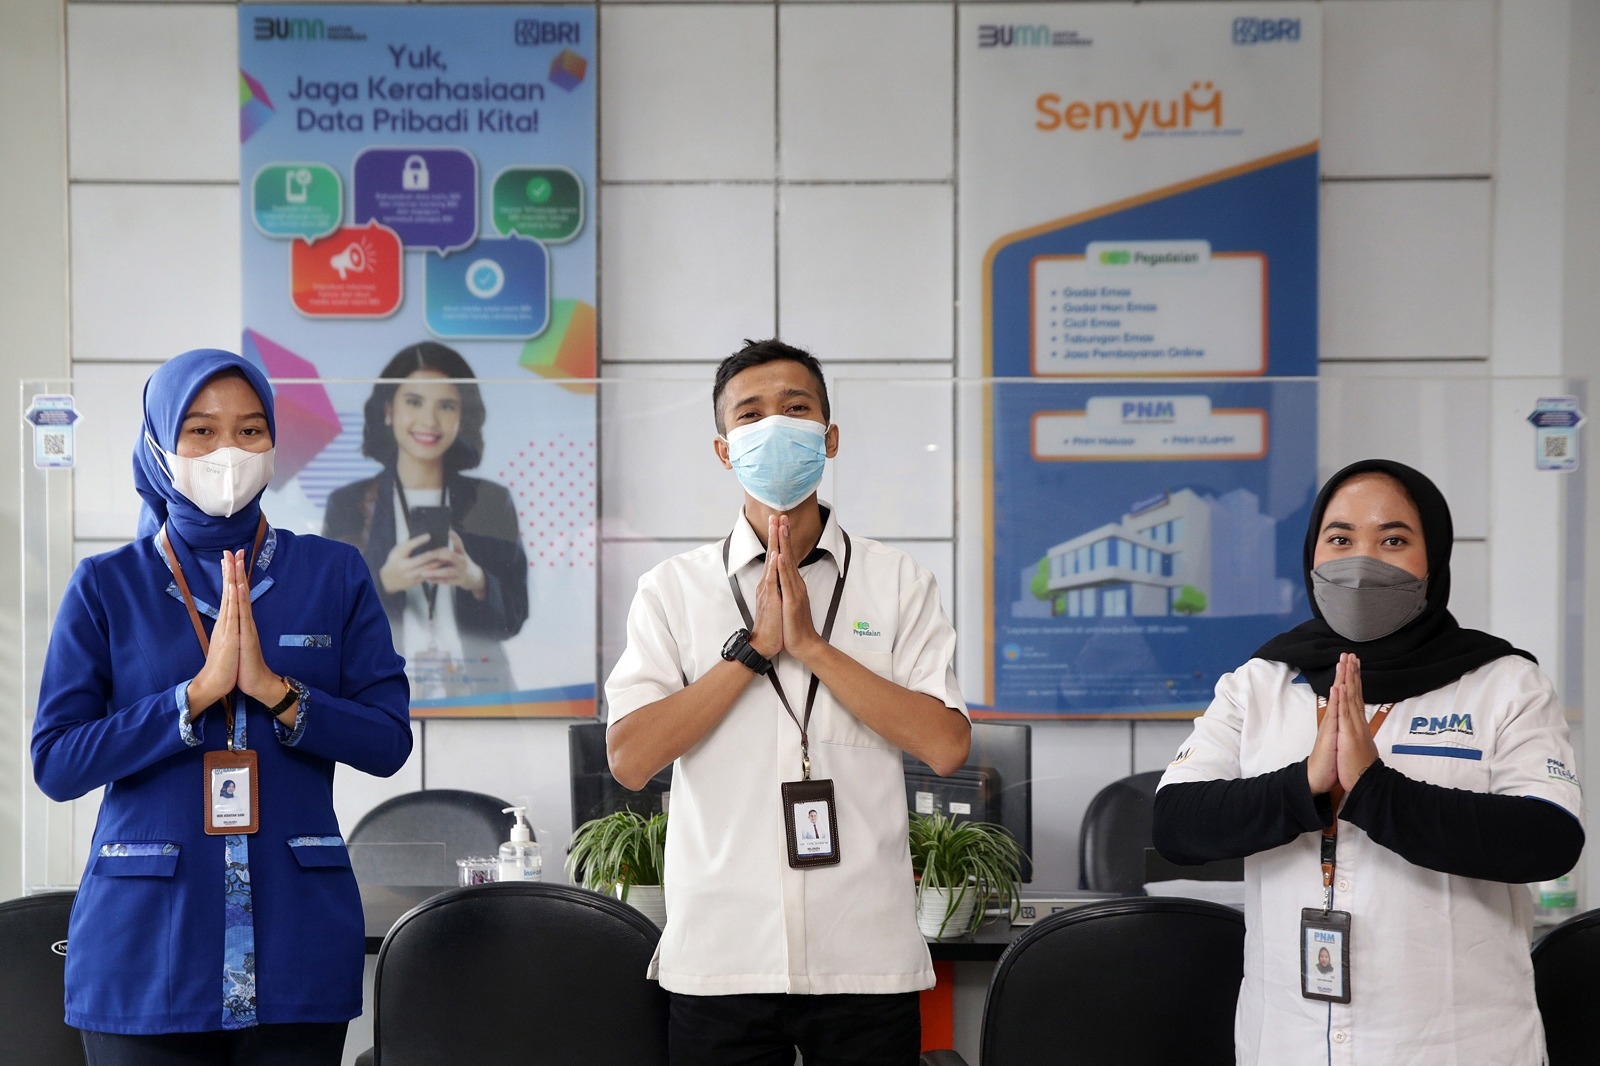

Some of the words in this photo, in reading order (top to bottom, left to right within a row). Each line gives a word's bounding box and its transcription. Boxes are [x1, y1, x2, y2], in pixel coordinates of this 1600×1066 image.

[254, 17, 326, 41] BUMN
[540, 21, 581, 45] BRI
[978, 24, 1050, 48] BUMN
[1260, 18, 1302, 42] BRI
[388, 44, 448, 71] Yuk,
[288, 77, 359, 106] Jaga
[368, 76, 545, 102] Kerahasiaan
[297, 108, 364, 133] Data
[373, 107, 469, 133] Pribadi
[1133, 251, 1199, 268] Pegadaian
[1168, 346, 1205, 358] Online
[1121, 401, 1175, 418] PNM
[1409, 713, 1474, 732] PNM
[1314, 931, 1335, 942] PNM
